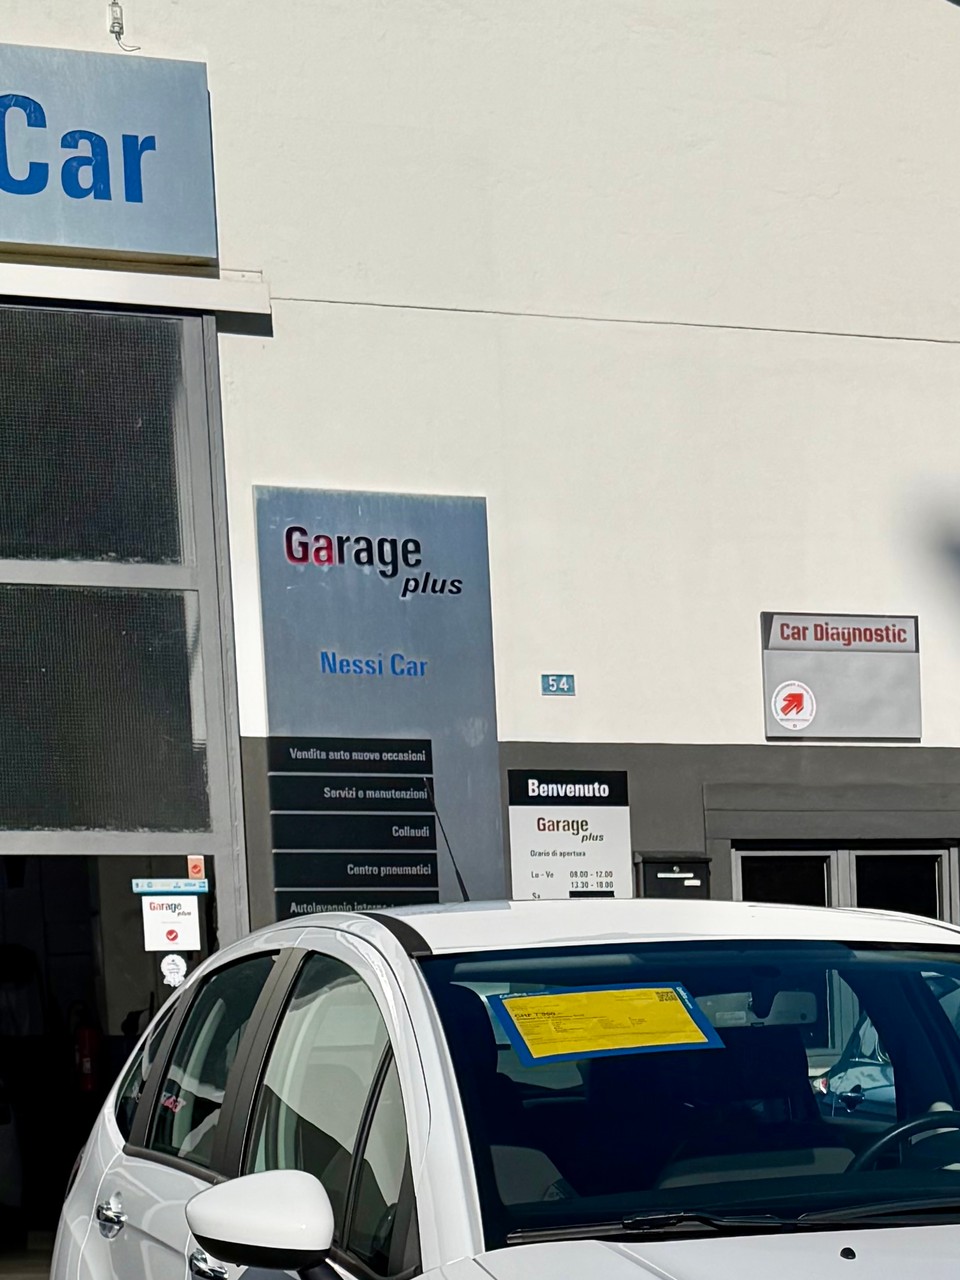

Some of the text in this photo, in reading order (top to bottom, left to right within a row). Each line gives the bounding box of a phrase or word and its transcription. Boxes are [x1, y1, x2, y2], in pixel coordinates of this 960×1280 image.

[0, 93, 156, 204] Car
[284, 525, 423, 579] Garage
[401, 572, 464, 598] plus
[779, 622, 908, 647] Car Diagnostic
[320, 651, 429, 677] Nessi Car
[548, 676, 569, 692] 54
[289, 748, 327, 760] Vendita
[328, 750, 350, 760] auto
[381, 750, 426, 761] occasioni
[323, 786, 356, 799] Servizi
[365, 787, 428, 800] manutenzioni
[528, 778, 610, 798] Benvenuto
[391, 826, 430, 838] Collaudi
[536, 817, 590, 836] Garage
[581, 832, 604, 843] plus
[530, 849, 586, 859] Orario di apertura
[346, 863, 432, 877] Centro pneumatici
[545, 870, 555, 879] Ve
[569, 870, 589, 879] 08.00
[595, 870, 614, 879] 12.00
[149, 902, 182, 913] Garage
